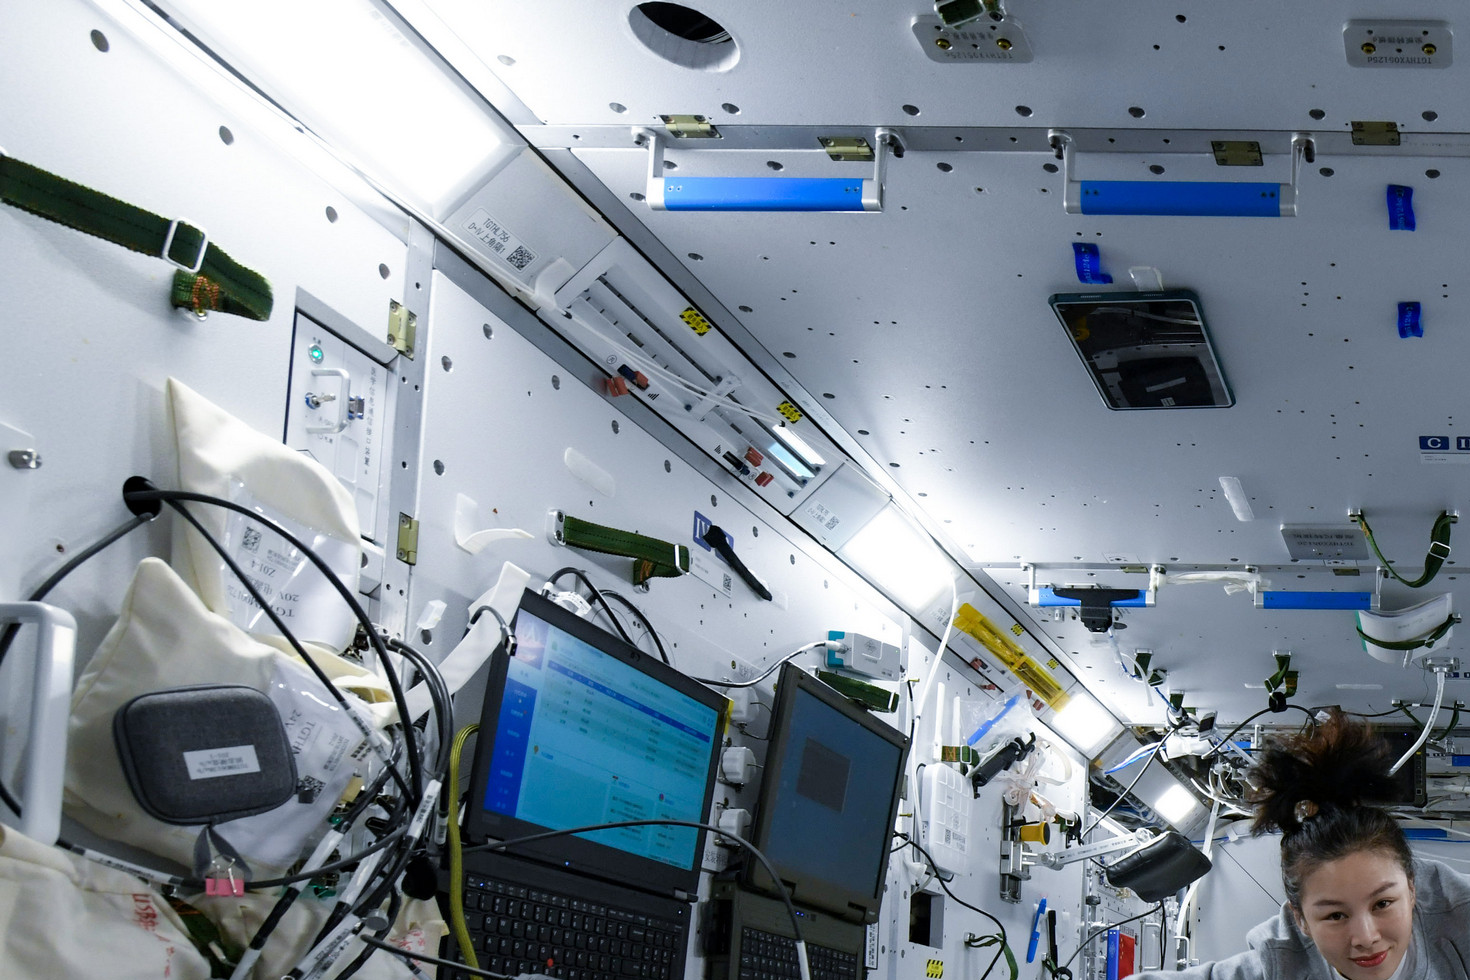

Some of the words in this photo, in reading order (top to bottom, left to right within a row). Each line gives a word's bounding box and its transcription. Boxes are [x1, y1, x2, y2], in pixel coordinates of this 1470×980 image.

[1367, 55, 1431, 64] TGTHYX05125d
[482, 217, 510, 243] TGTHL756
[1427, 439, 1441, 448] C
